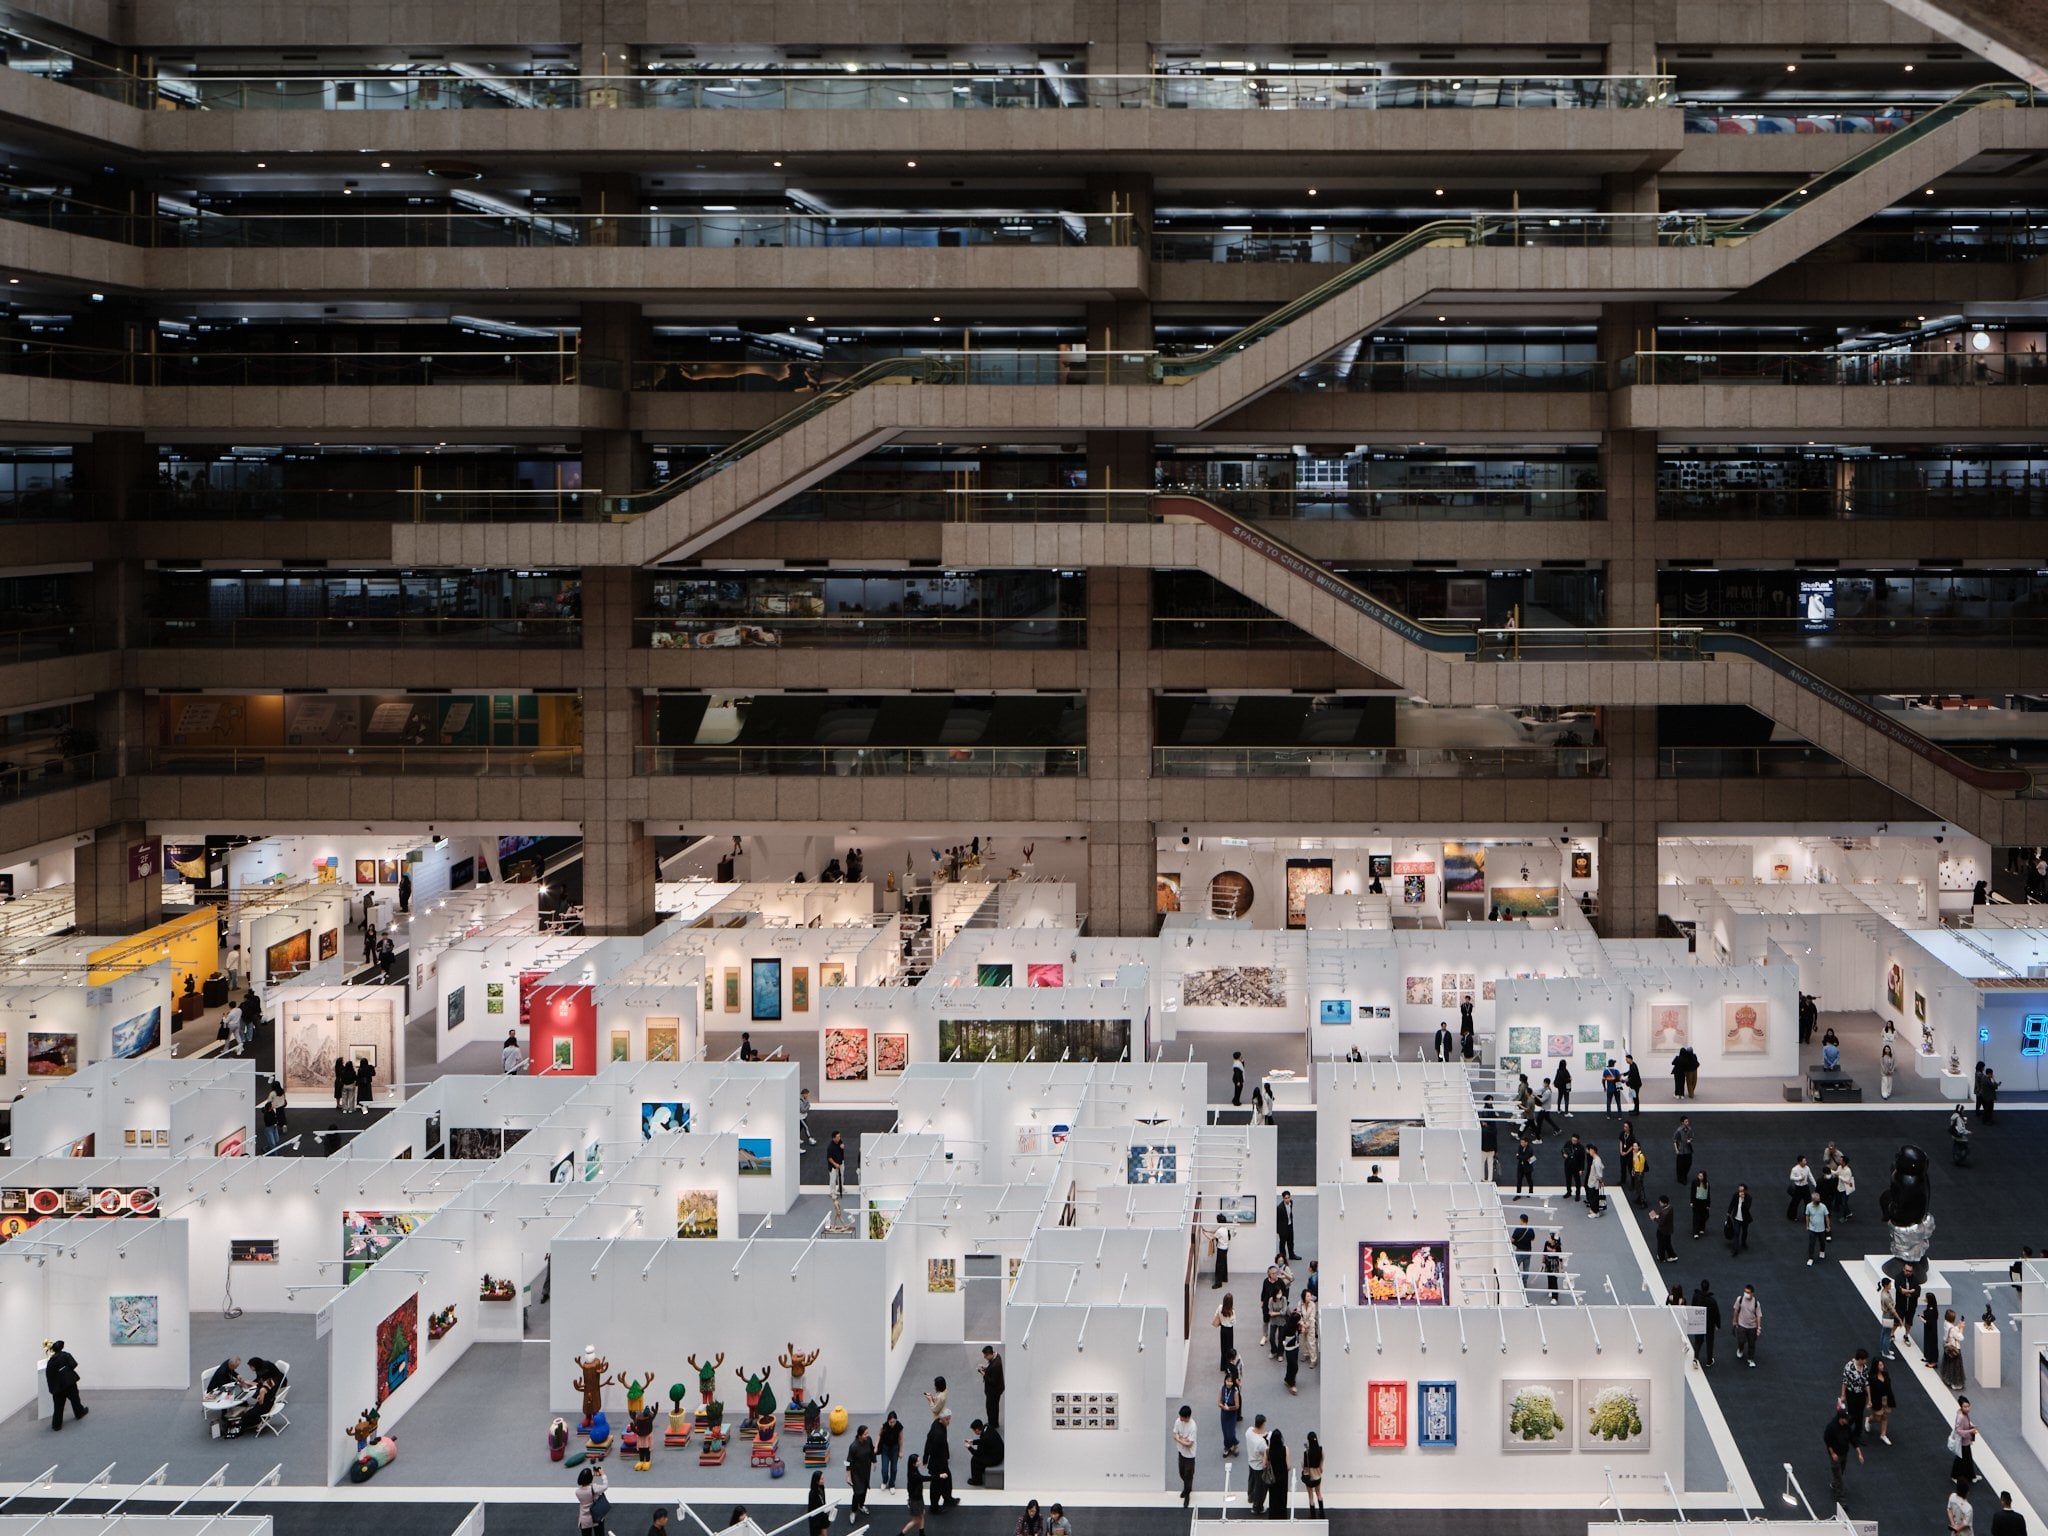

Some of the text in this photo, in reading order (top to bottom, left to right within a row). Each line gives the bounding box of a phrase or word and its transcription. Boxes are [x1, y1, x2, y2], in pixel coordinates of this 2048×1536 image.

[1232, 526, 1423, 641] SPACE TO CREATE WHERE IDEAS ELEVATE
[1788, 669, 1928, 754] AND COLLABORATE TO INSPIRE
[140, 854, 149, 864] 2F
